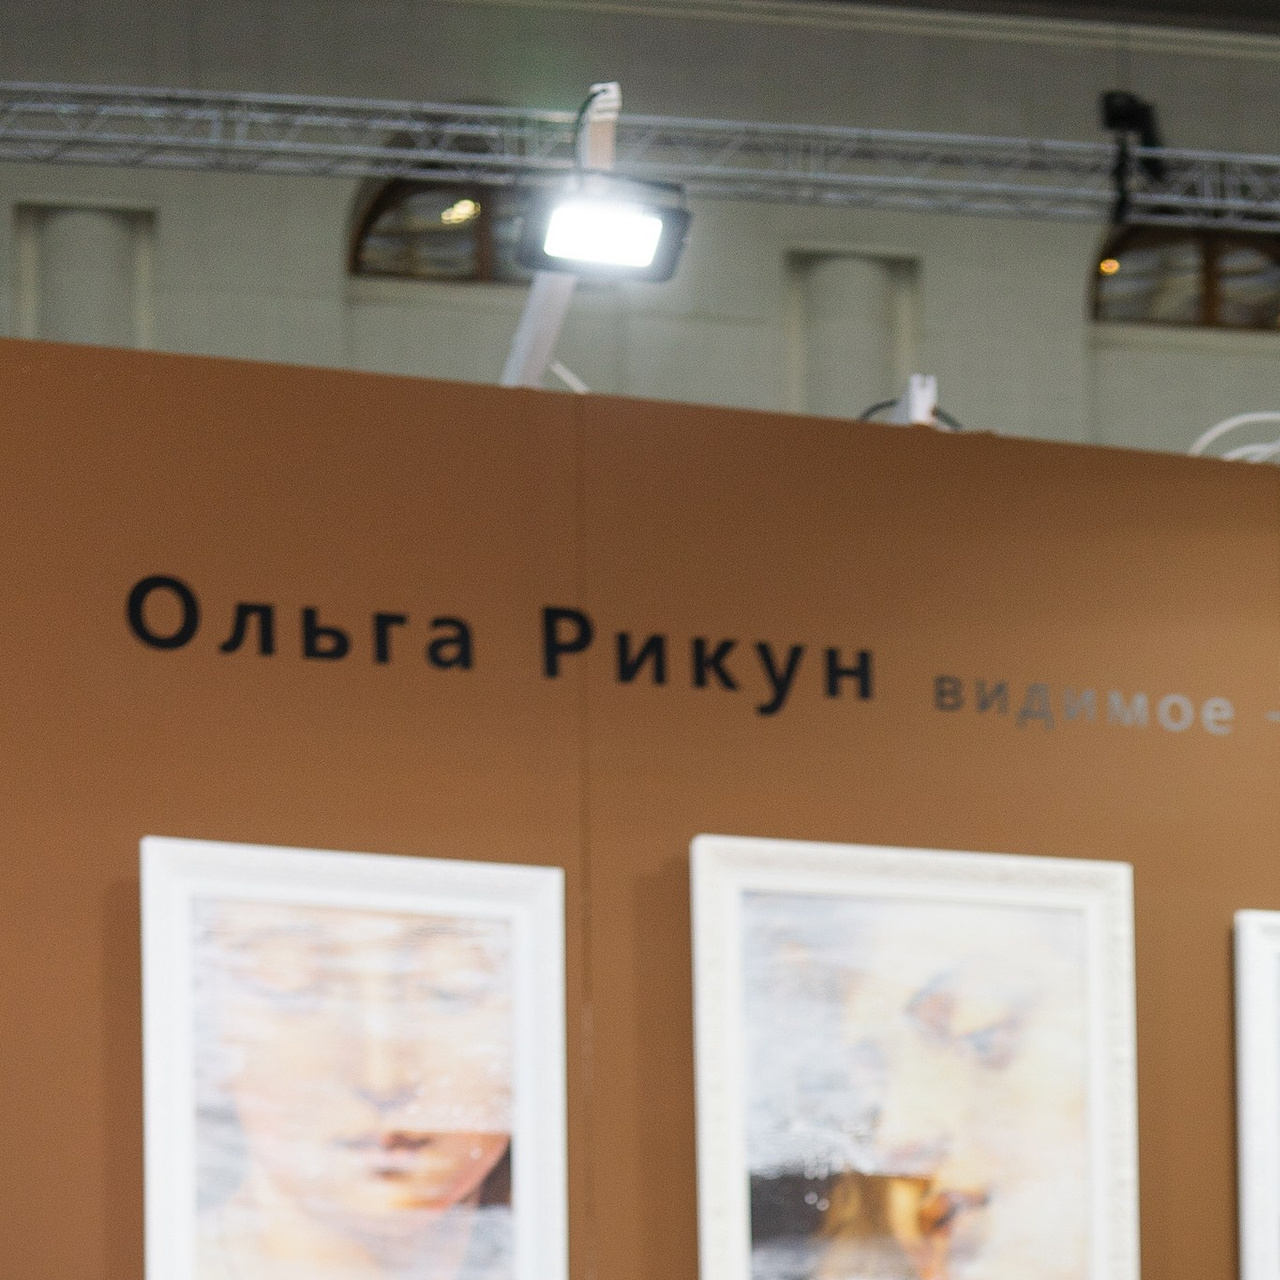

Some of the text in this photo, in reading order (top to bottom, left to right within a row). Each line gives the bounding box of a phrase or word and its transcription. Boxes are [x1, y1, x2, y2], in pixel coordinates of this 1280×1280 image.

[125, 573, 873, 717] Ольга Рикун
[932, 674, 1236, 736] видимое
